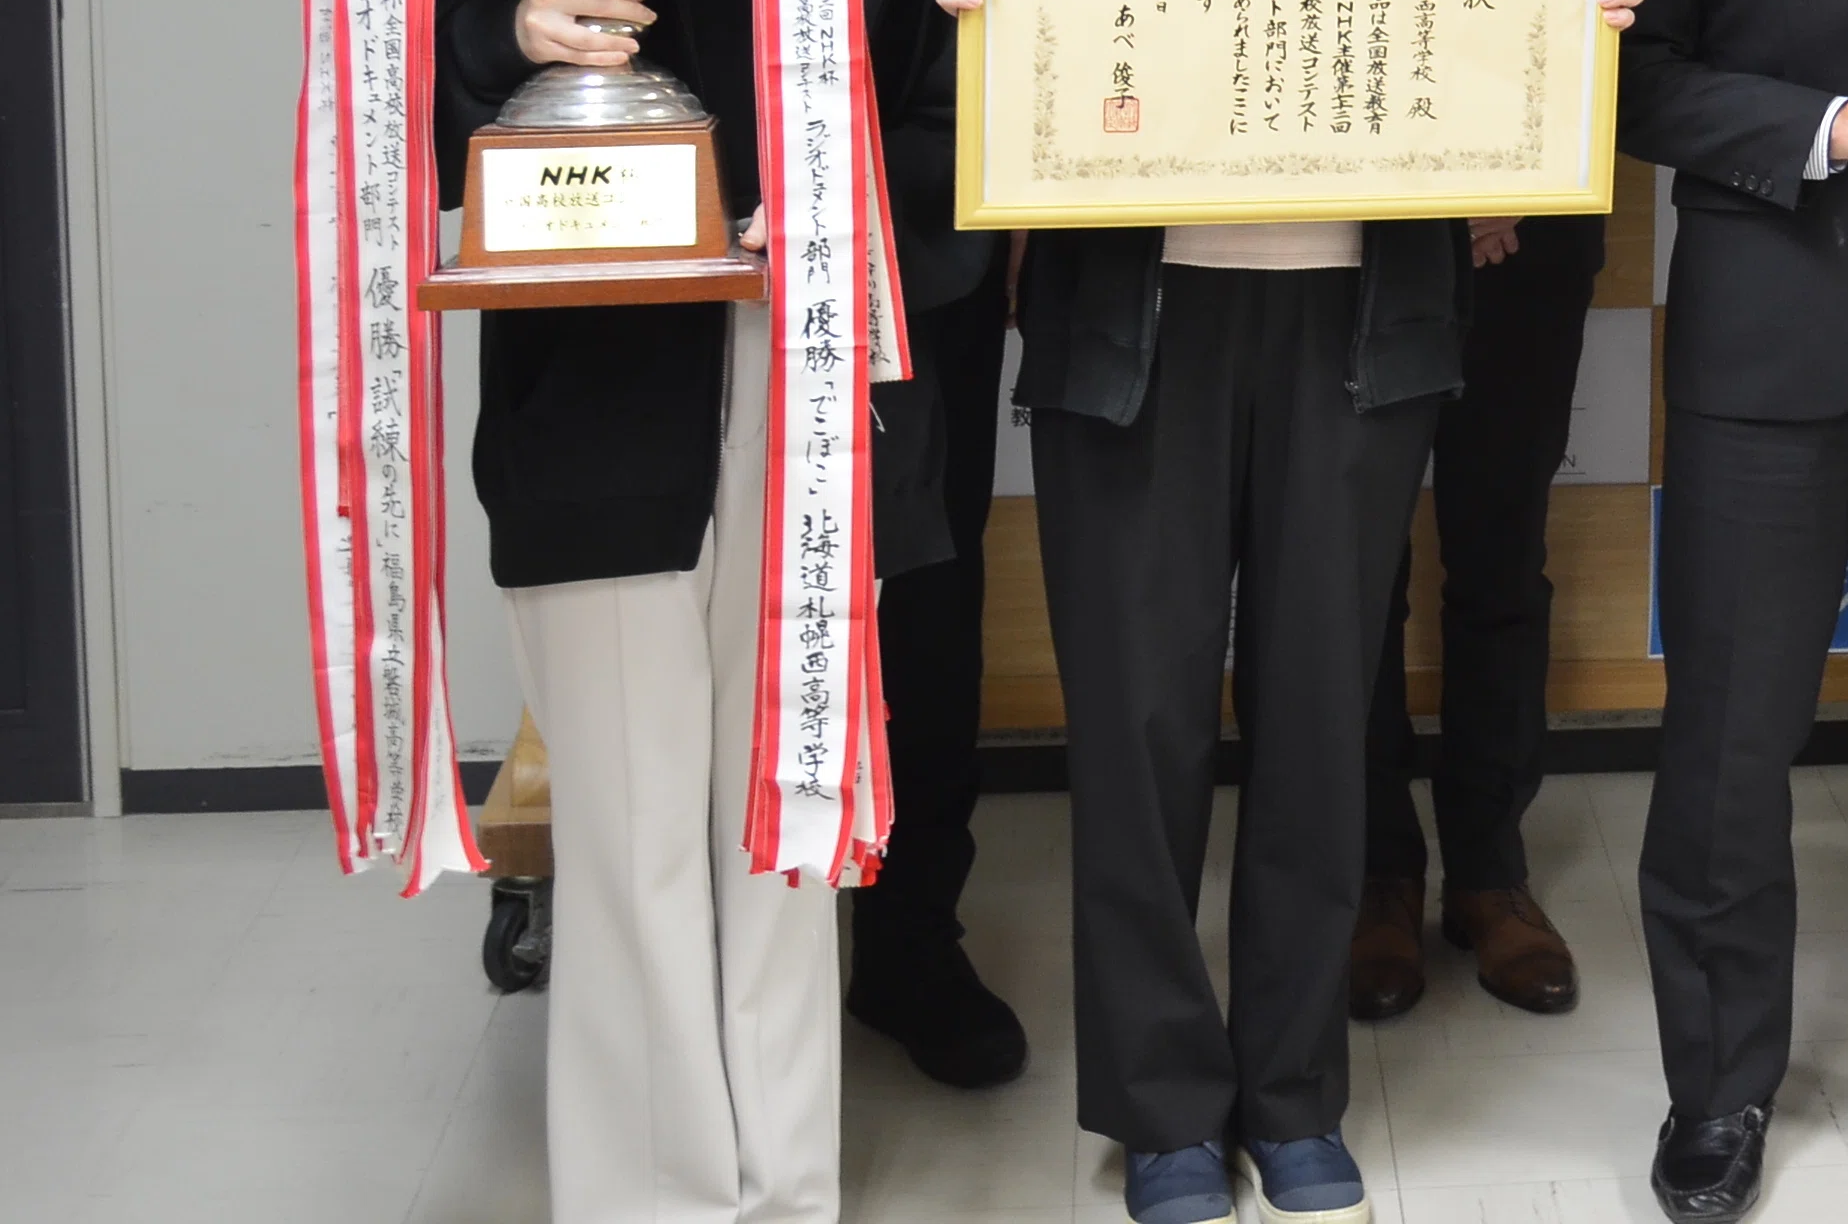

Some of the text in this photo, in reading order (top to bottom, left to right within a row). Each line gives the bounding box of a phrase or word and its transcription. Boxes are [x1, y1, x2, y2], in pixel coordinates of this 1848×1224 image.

[1113, 4, 1135, 49] あべ
[1406, 97, 1438, 120] 殿
[540, 164, 612, 186] NHK
[794, 508, 841, 802] 北海道札幌西高等学校
